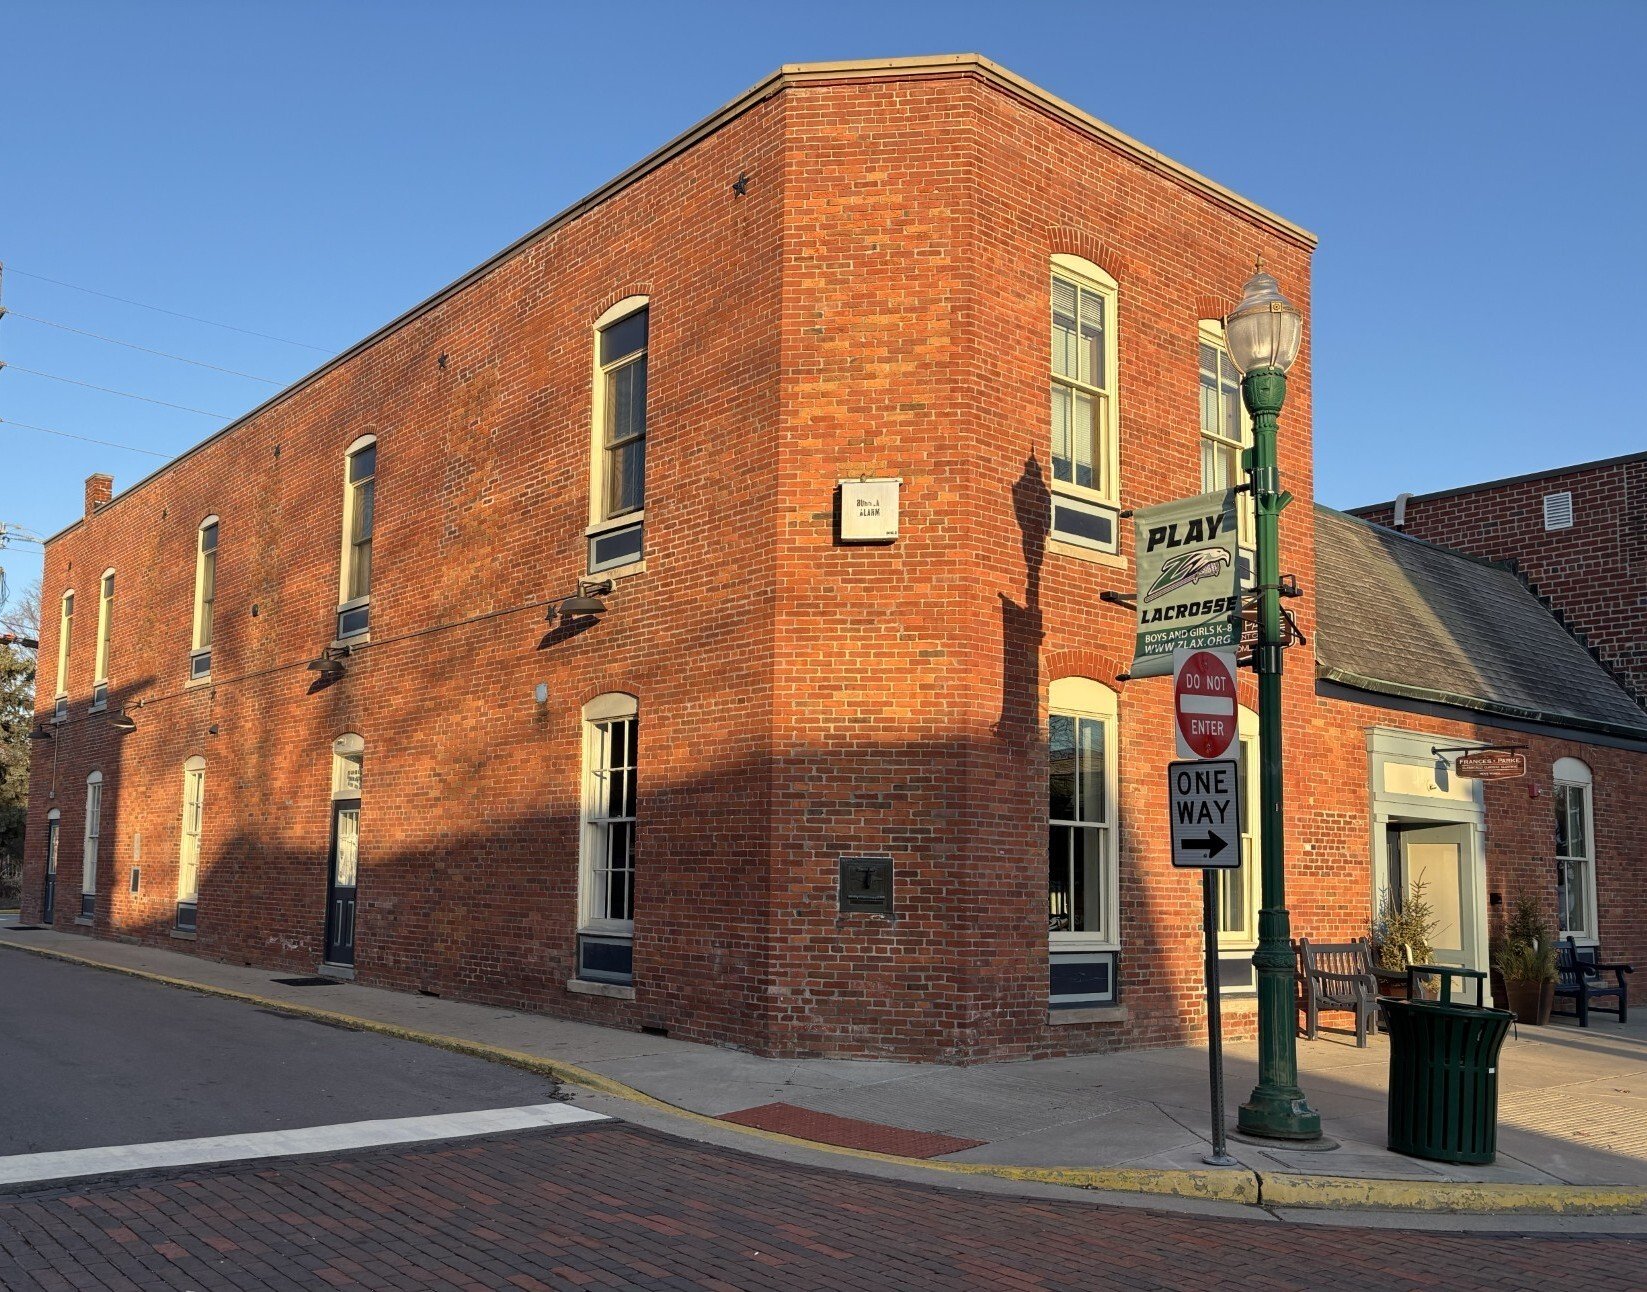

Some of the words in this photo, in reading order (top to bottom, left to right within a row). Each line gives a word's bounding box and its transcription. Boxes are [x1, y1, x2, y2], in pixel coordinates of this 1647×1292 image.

[859, 508, 880, 516] ALARM
[1146, 513, 1225, 553] PLAY
[1141, 596, 1238, 624] LACROSSE
[1145, 632, 1167, 643] BOYS
[1168, 629, 1188, 640] AND
[1189, 625, 1215, 637] GIRLS
[1216, 623, 1233, 634] K-8
[1144, 635, 1231, 653] WWWZLAX.ORG
[1186, 673, 1200, 689] DO
[1206, 675, 1227, 691] NOT
[1191, 719, 1224, 736] ENTER
[1177, 769, 1229, 796] ONE
[1176, 799, 1231, 825] WAY
